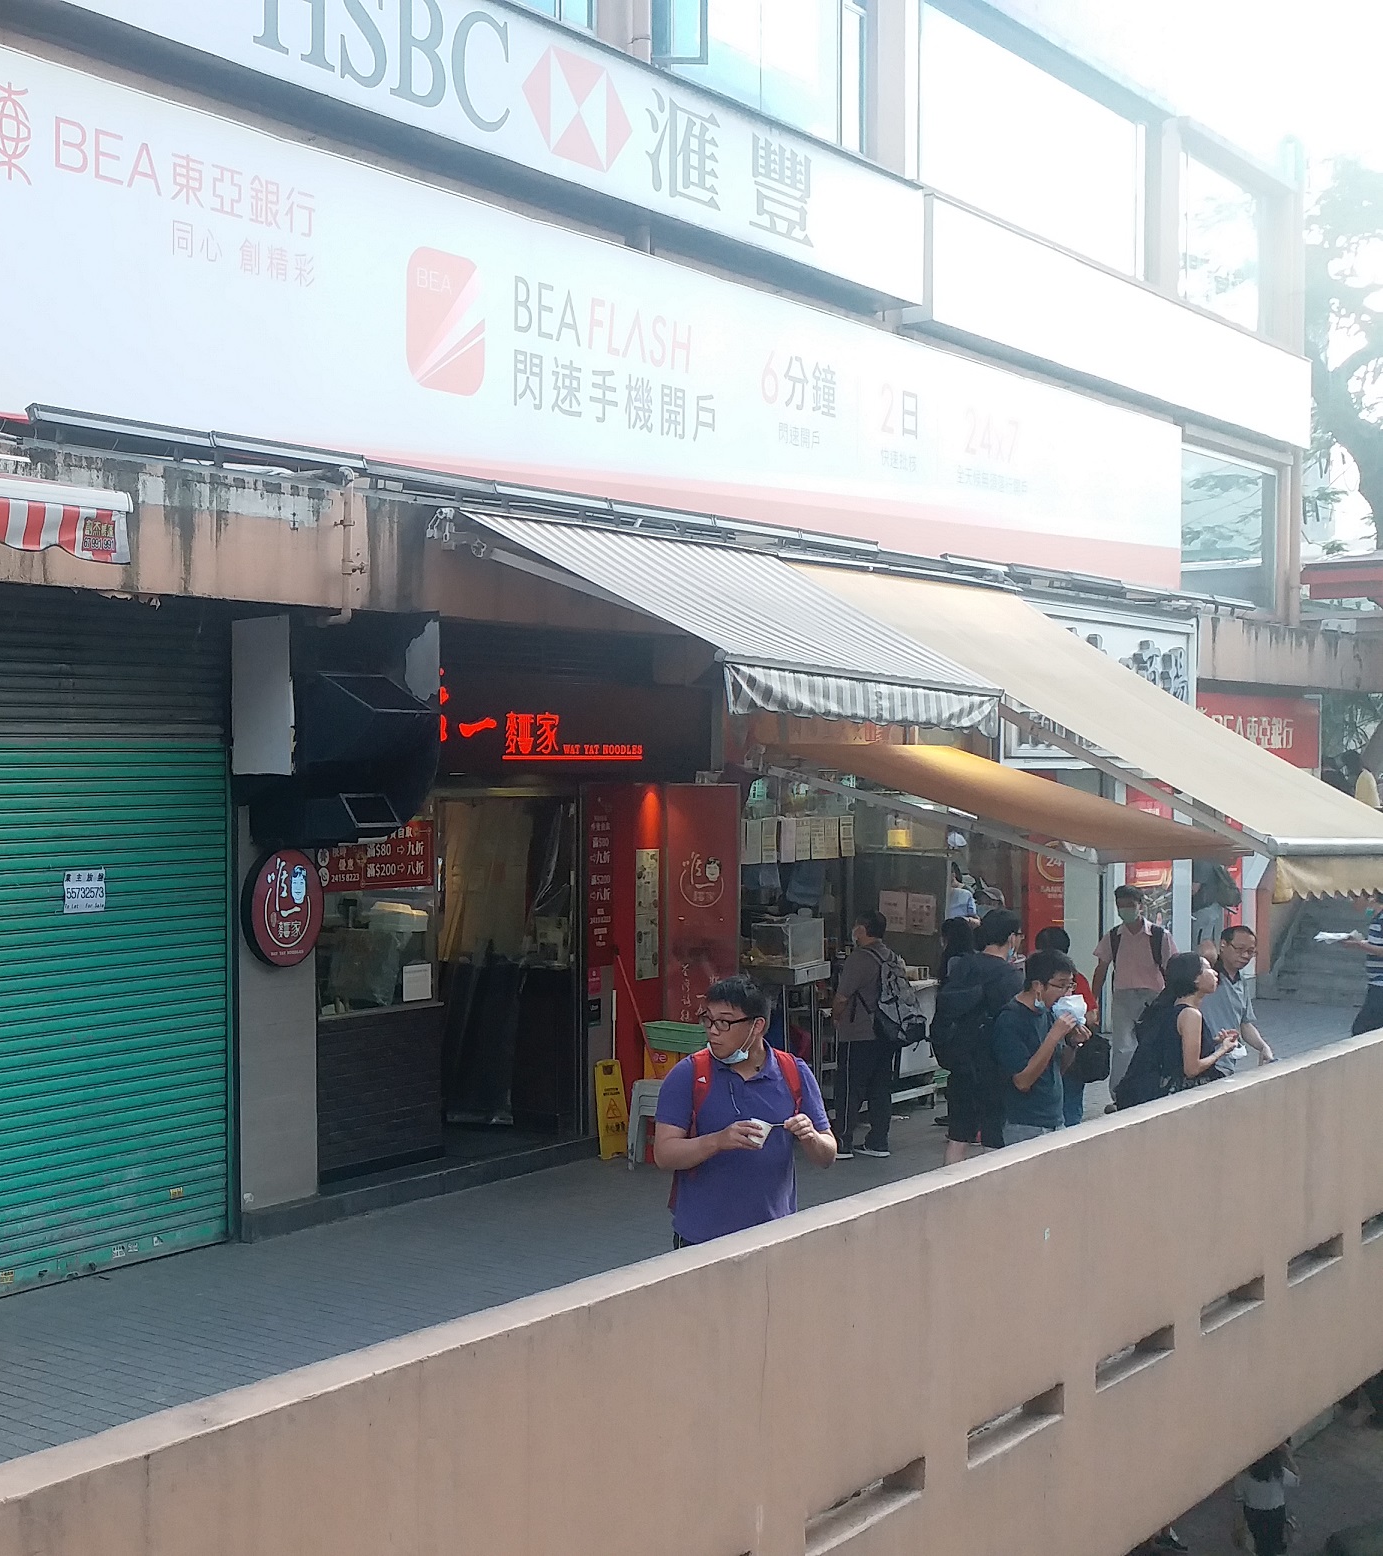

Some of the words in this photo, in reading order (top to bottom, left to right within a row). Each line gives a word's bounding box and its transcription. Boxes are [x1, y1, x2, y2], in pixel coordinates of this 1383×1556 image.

[54, 116, 162, 196] BEA
[170, 152, 316, 238] 東亞銀行
[171, 219, 222, 262] 同心
[239, 240, 315, 288] 創精彩
[417, 266, 452, 295] BEA
[513, 274, 581, 347] BEA
[587, 296, 692, 374] FLASH
[512, 348, 717, 443] 閃速手機開戶
[760, 350, 837, 419] 6分鐘
[879, 382, 918, 440] 2日
[584, 744, 600, 755] YAT
[603, 744, 643, 755] NOODLES
[366, 863, 396, 878] 滿$200
[406, 860, 424, 876] 八折
[406, 840, 424, 856] 九折
[66, 887, 104, 899] 55732573
